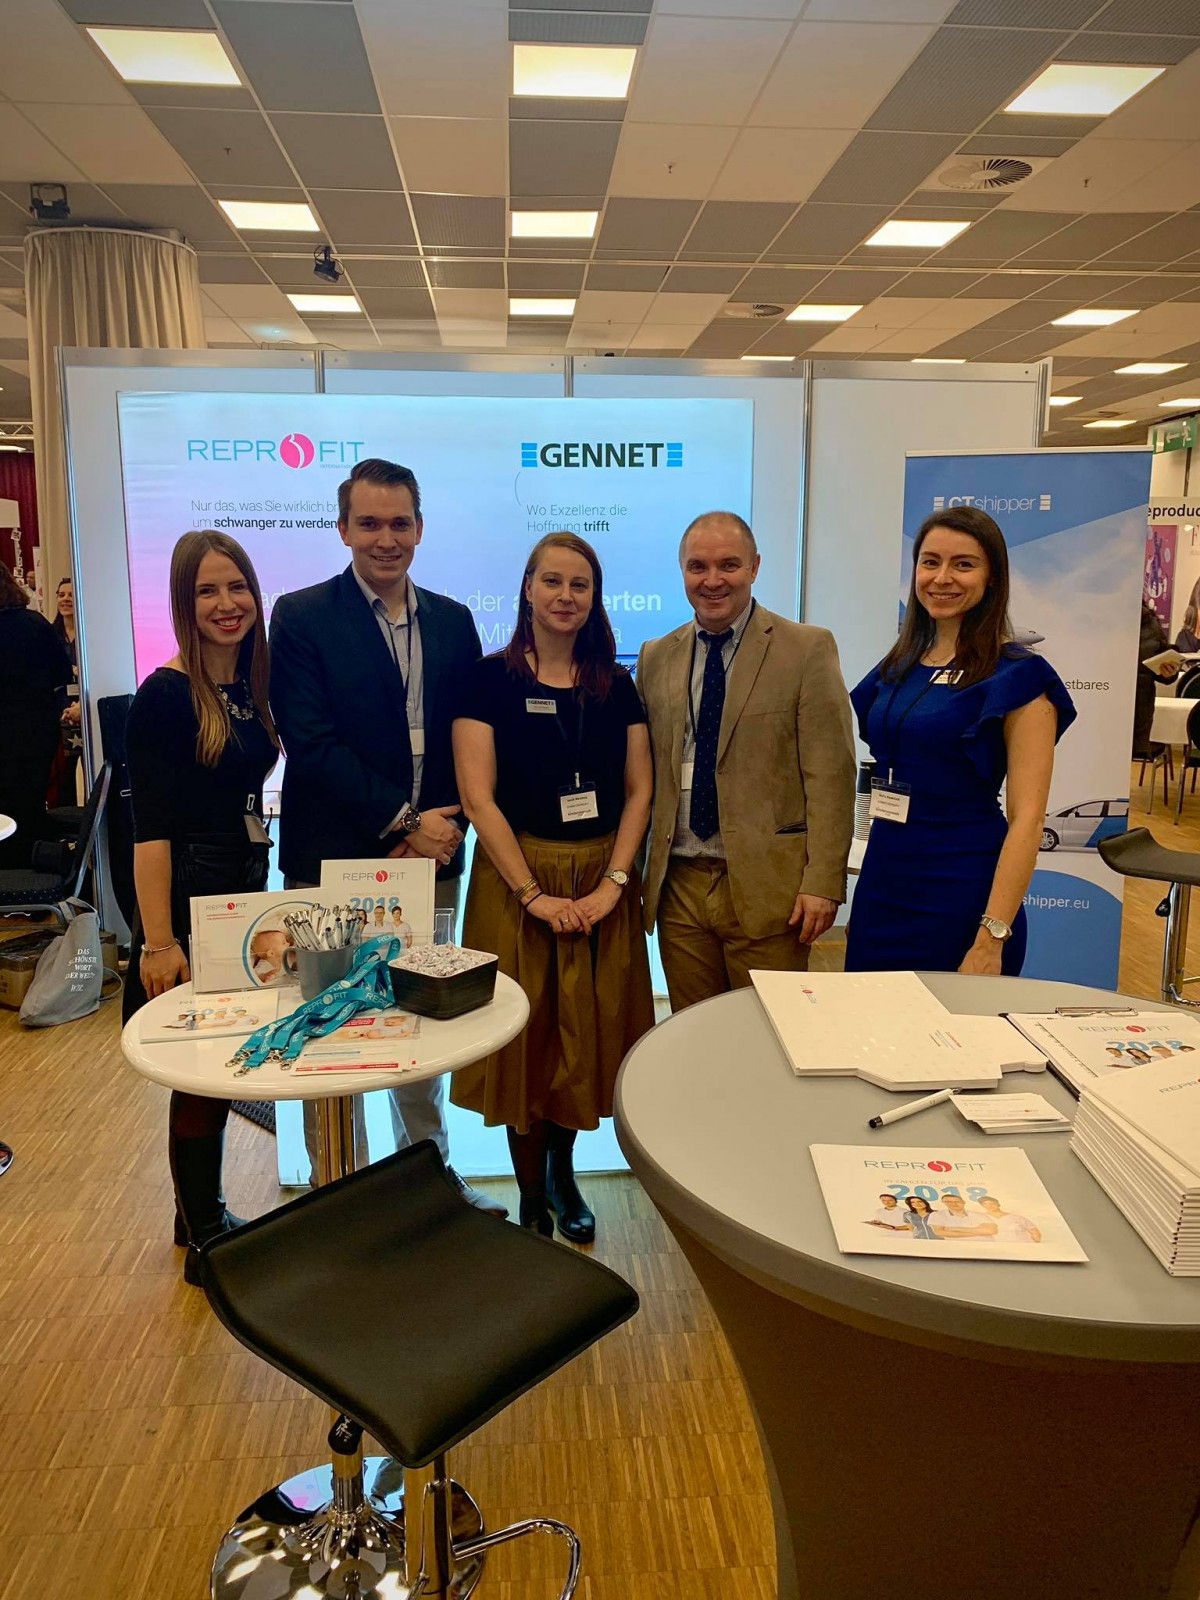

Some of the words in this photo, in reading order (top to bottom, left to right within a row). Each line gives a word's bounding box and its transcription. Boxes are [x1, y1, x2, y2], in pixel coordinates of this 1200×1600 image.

[540, 442, 664, 468] GENNET
[191, 500, 212, 512] Nur
[214, 500, 237, 513] das,
[240, 503, 263, 512] was
[265, 500, 281, 512] Sie
[284, 500, 325, 513] wirklich
[526, 504, 547, 516] Wo
[551, 504, 606, 516] Exzellenz
[609, 504, 627, 516] die
[193, 519, 212, 528] um
[214, 516, 276, 530] schwanger
[279, 519, 293, 529] zu
[527, 520, 580, 534] Hoffnung
[583, 520, 610, 532] trifft
[466, 589, 505, 612] der
